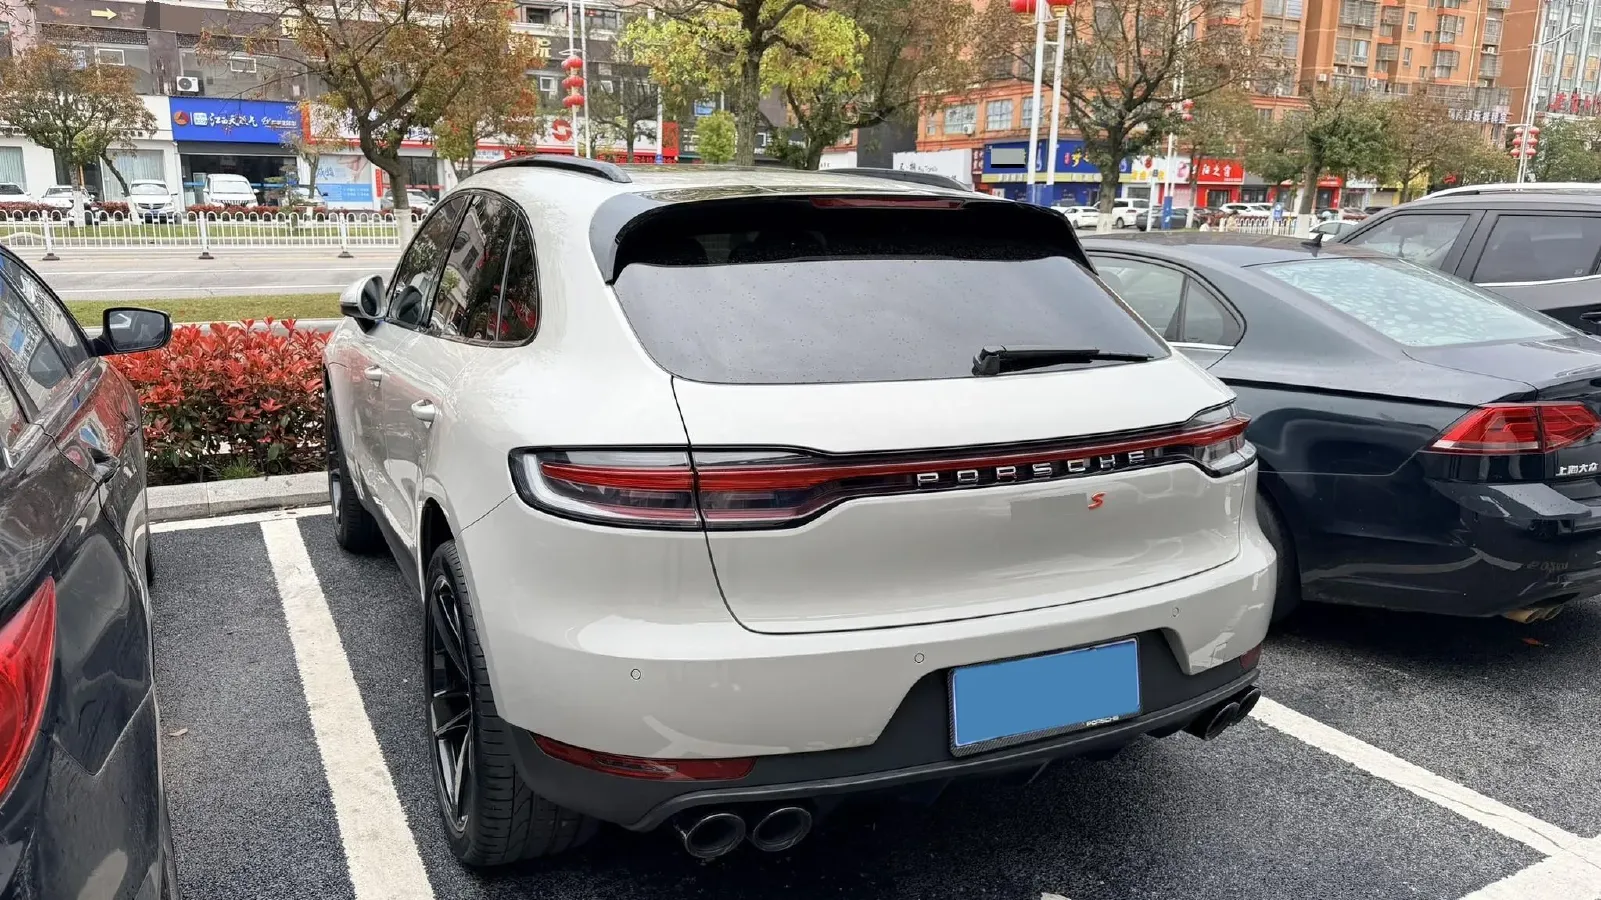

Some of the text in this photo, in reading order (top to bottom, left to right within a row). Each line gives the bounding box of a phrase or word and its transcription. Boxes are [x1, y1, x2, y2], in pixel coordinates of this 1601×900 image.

[917, 450, 1145, 486] PORSCHE
[1555, 462, 1599, 476] 上海大众
[1088, 492, 1105, 510] S
[1086, 715, 1120, 726] PORSCHE
